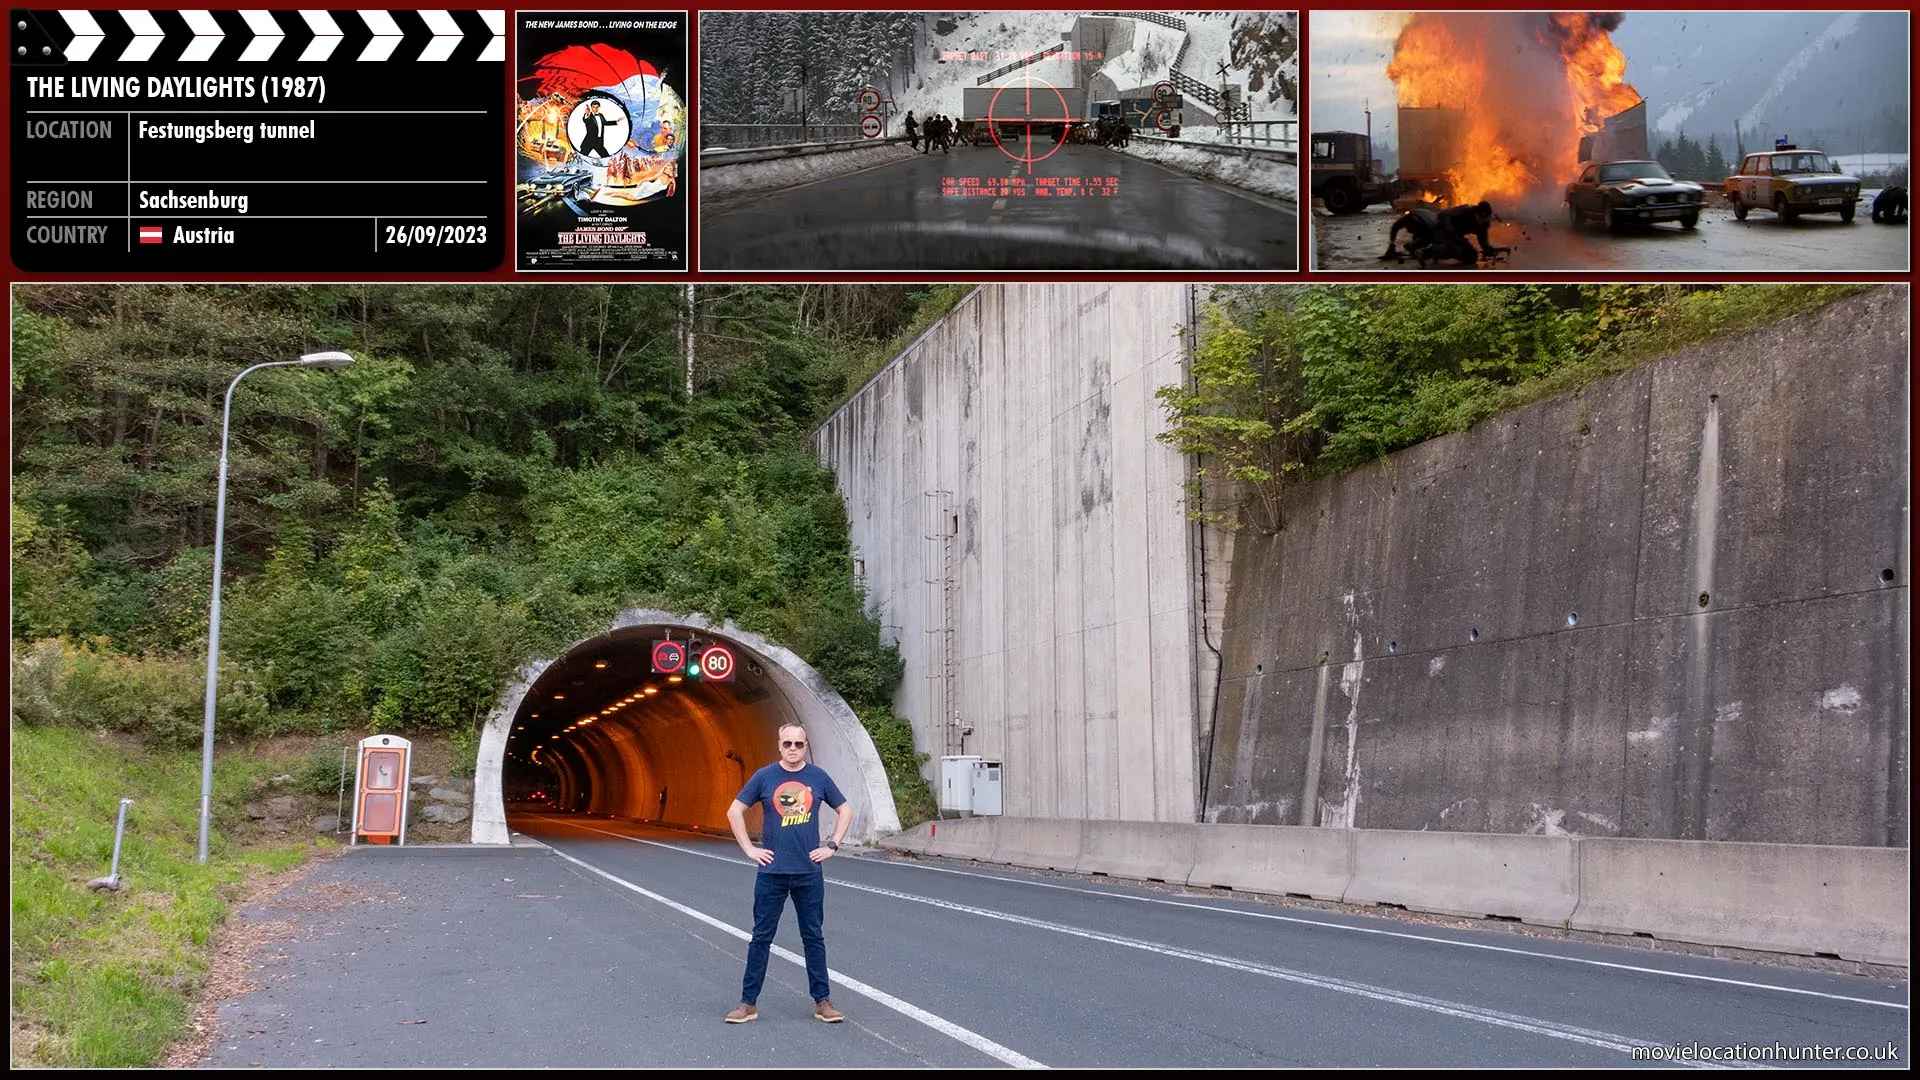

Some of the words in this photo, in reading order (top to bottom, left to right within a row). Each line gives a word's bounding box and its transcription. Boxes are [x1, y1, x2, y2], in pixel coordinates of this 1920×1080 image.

[525, 21, 538, 29] THE
[538, 21, 555, 29] NEW
[555, 21, 578, 29] JAMES
[578, 21, 599, 29] BOND
[609, 21, 632, 29] LIVING
[633, 21, 645, 29] ON
[645, 21, 658, 29] THE
[658, 21, 677, 29] EDGE
[959, 177, 980, 187] SPEED
[1035, 177, 1060, 187] TARGET
[1064, 177, 1080, 187] TIME
[1105, 177, 1119, 187] SEC
[942, 187, 959, 197] SAFE
[962, 187, 997, 197] DISTANCE
[1101, 187, 1111, 197] 32
[1113, 187, 1119, 197] F
[558, 232, 574, 245] THE
[575, 232, 602, 245] LIVING
[604, 232, 646, 245] DAYLIGHTS
[708, 656, 727, 671] 80
